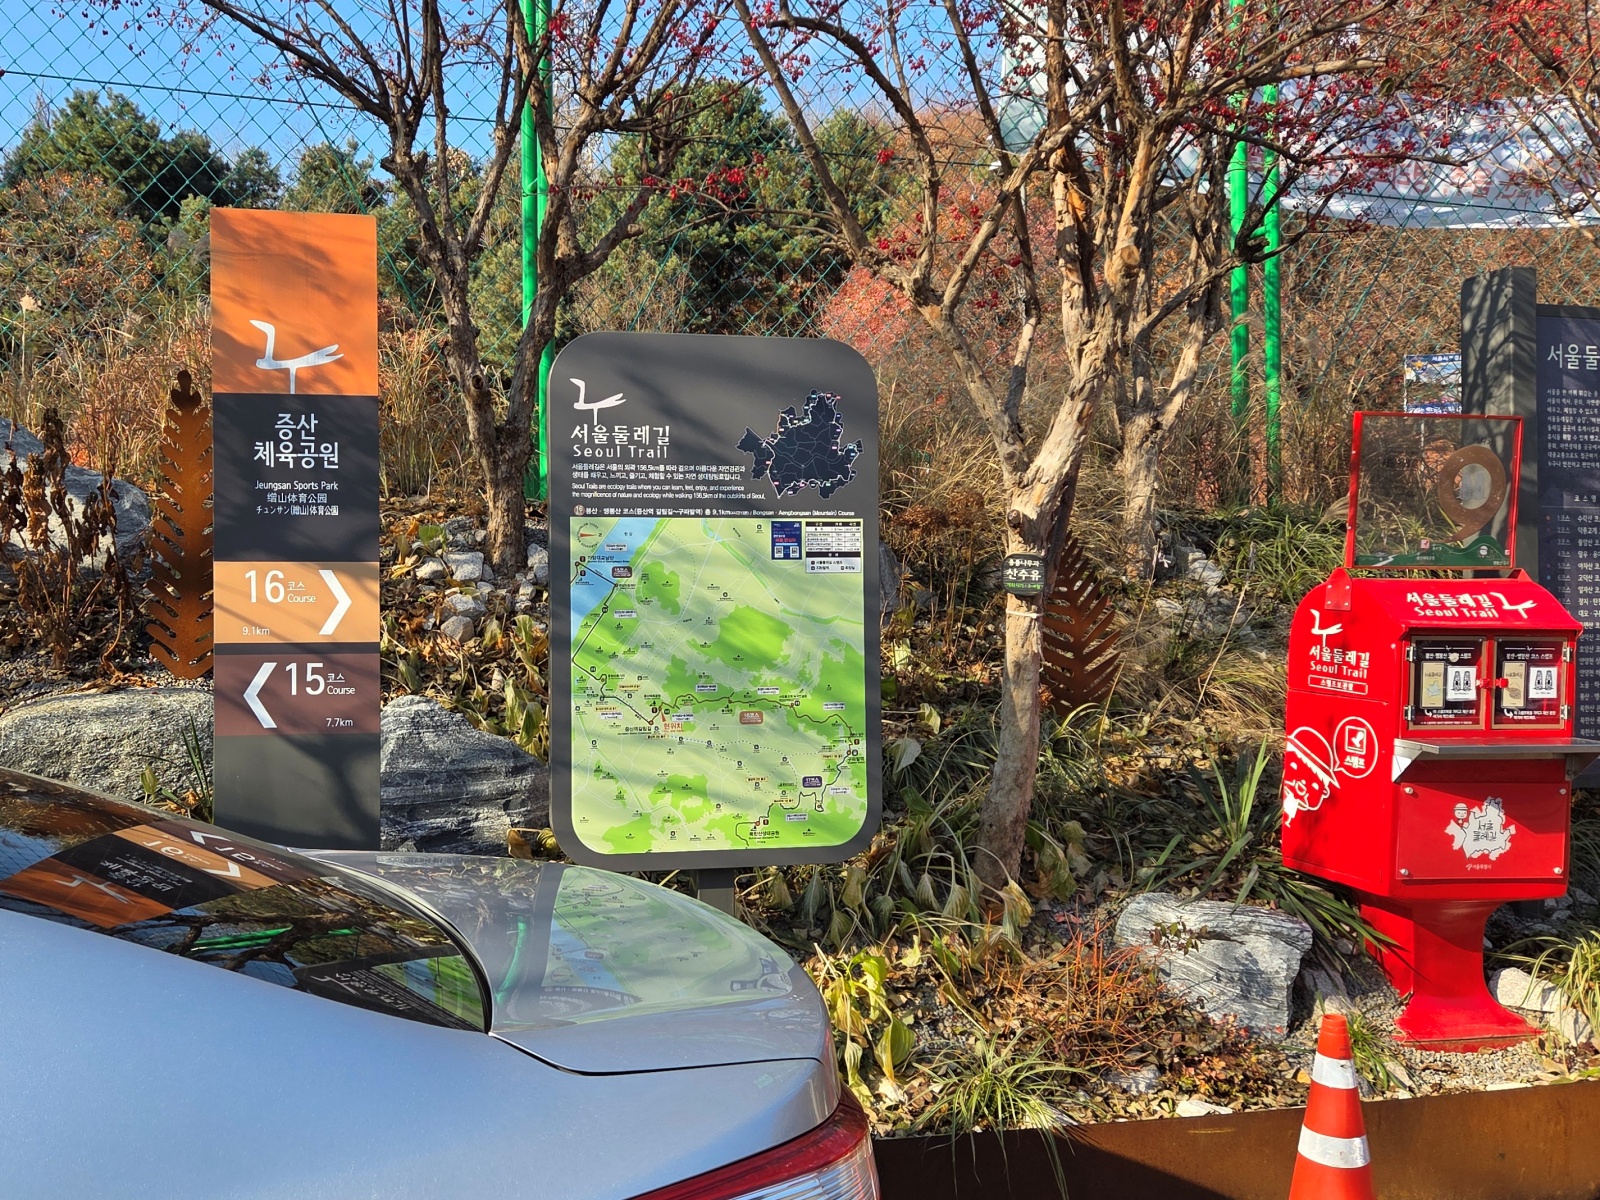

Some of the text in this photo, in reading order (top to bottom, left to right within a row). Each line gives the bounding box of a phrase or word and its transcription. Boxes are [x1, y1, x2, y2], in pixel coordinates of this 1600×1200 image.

[274, 413, 319, 440] 증산
[570, 424, 670, 445] 서울둘레길
[253, 441, 339, 469] 체육공원
[573, 444, 668, 459] Seoul Trail
[255, 480, 338, 492] Jeungsan Sports Park
[1006, 568, 1042, 582] 산수유
[244, 570, 306, 604] 16 코스
[287, 594, 316, 604] Course
[1406, 592, 1495, 608] 서울둘레길
[1414, 606, 1499, 618] Seoul Trail
[242, 626, 270, 636] 9.1km
[1582, 622, 1594, 630] 면산
[1309, 644, 1370, 668] 서울둘레길
[1310, 660, 1368, 680] Seoul Trail
[285, 662, 346, 696] 15 코스
[326, 686, 356, 696] Course
[326, 718, 354, 728] 7.7km
[1478, 820, 1494, 831] 서울
